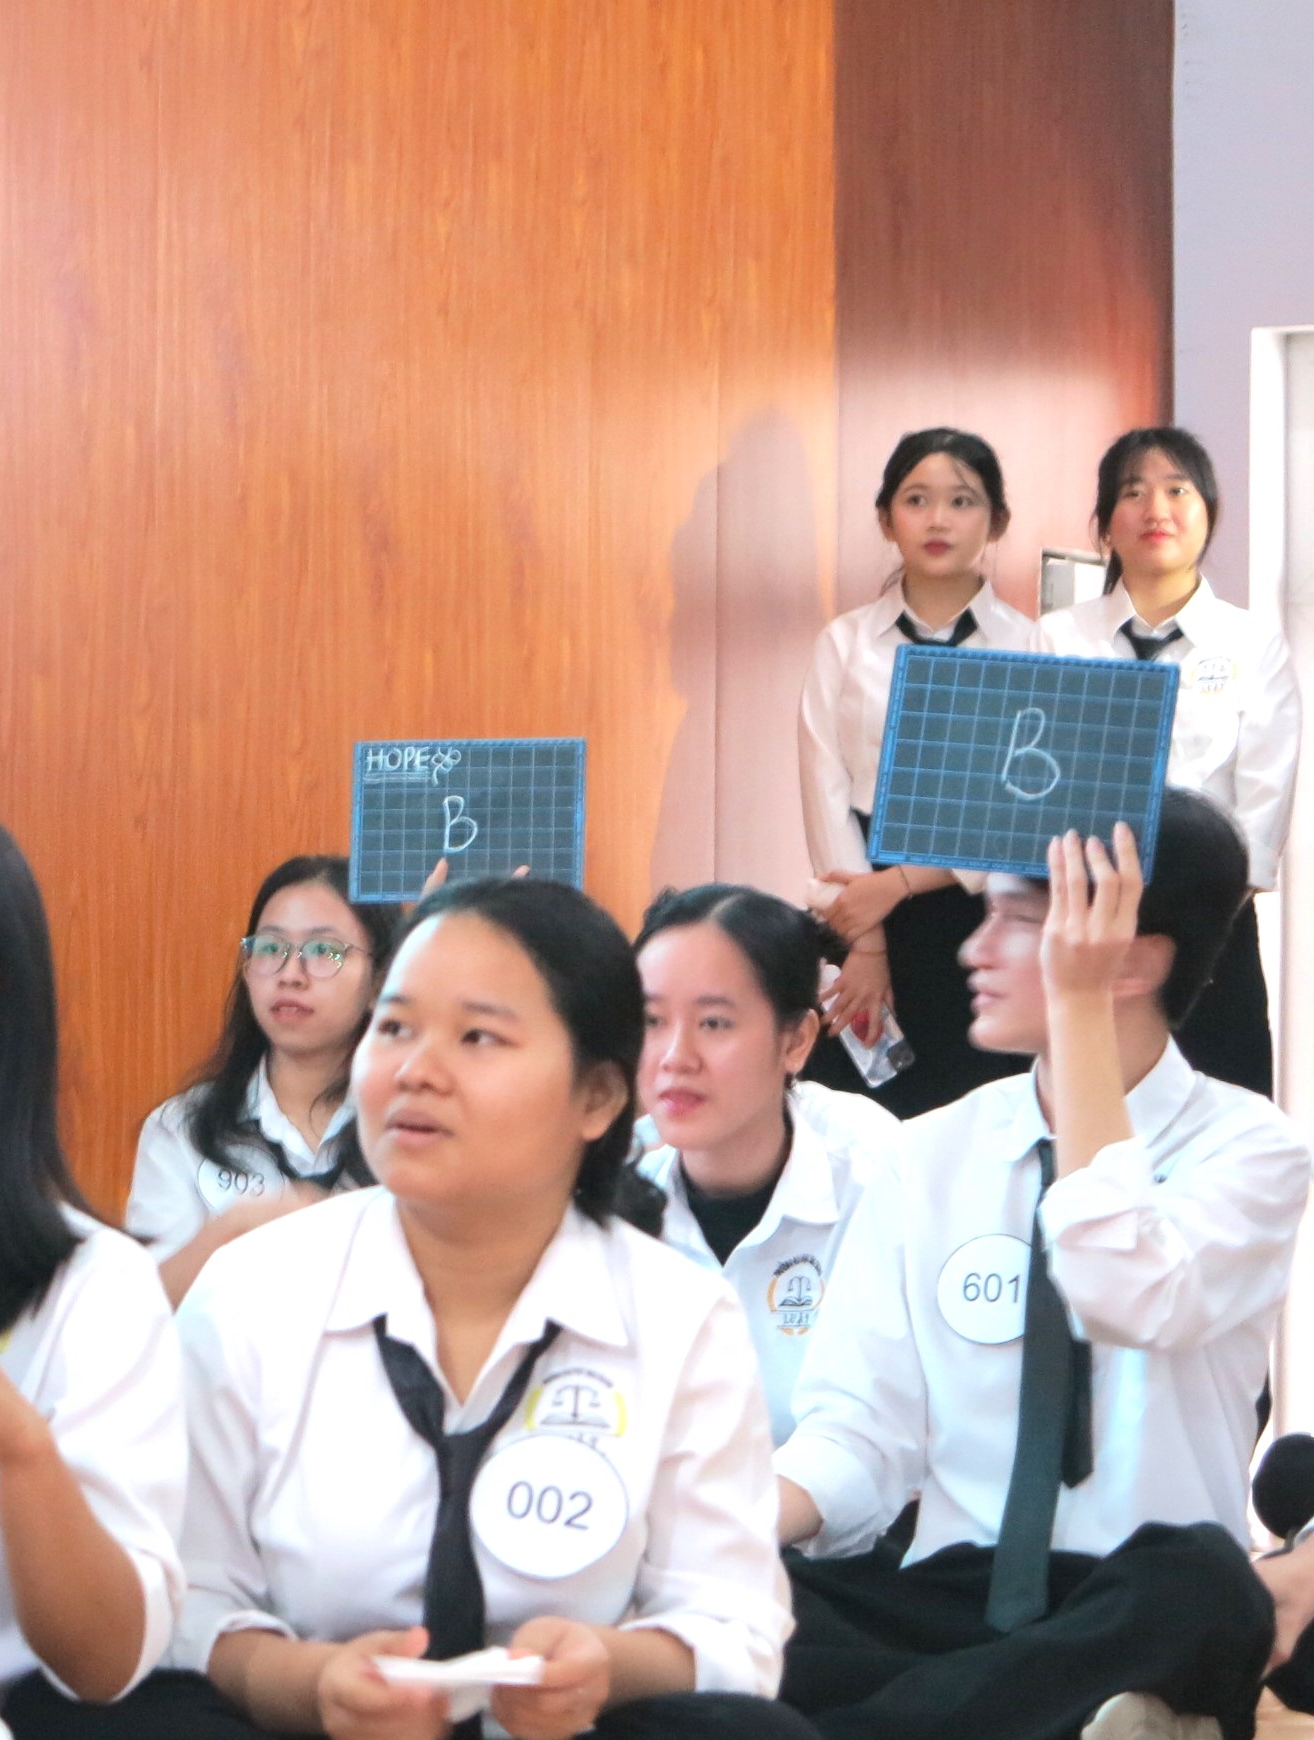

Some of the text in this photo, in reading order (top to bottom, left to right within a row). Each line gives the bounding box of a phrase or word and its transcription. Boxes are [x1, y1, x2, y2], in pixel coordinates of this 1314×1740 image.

[365, 746, 431, 773] HOPE
[1001, 706, 1061, 801] B
[442, 795, 478, 853] B
[217, 1170, 266, 1198] 903
[962, 1271, 1022, 1304] 601
[506, 1480, 594, 1532] 002
